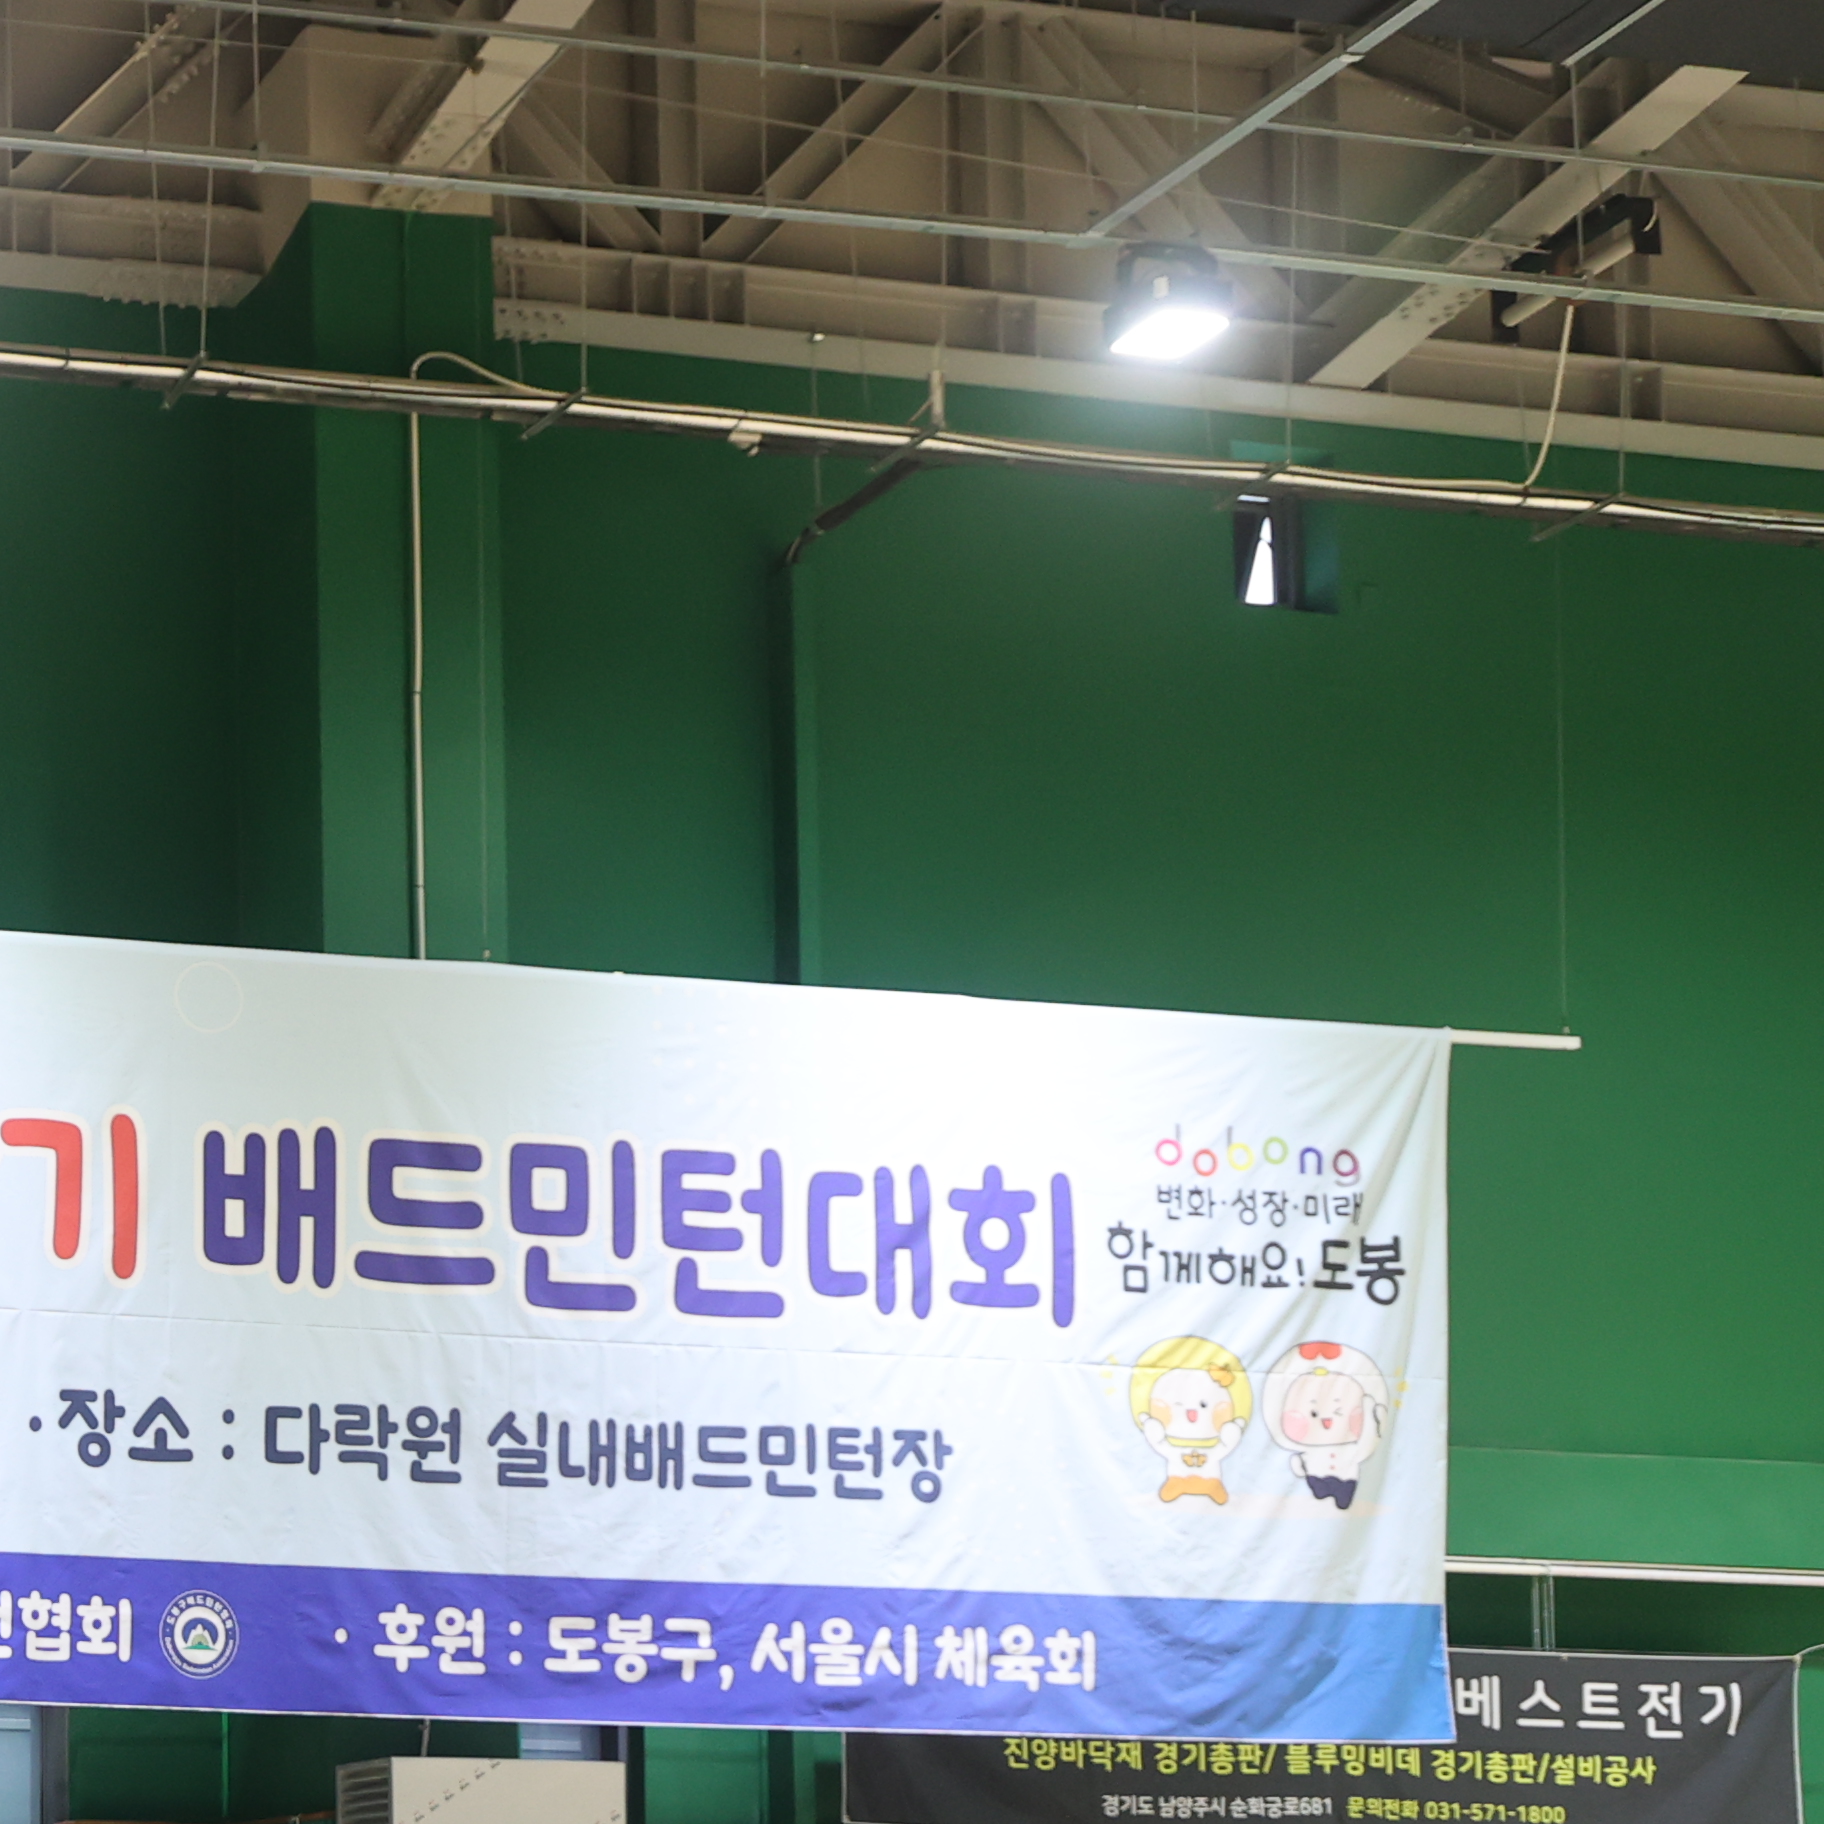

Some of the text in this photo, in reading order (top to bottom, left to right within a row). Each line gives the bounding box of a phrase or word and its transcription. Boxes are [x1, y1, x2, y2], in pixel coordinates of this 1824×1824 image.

[1155, 1124, 1361, 1186] dobong
[203, 1127, 1074, 1328] 배드민턴대회
[1312, 1235, 1405, 1305] 도봉
[264, 1401, 462, 1484] 다락원
[487, 1410, 952, 1502] 실내배드민턴장
[373, 1603, 486, 1676] 후원
[543, 1613, 735, 1693] 도봉구,
[751, 1617, 918, 1689] 서울시
[933, 1623, 1096, 1693] 체육회
[1002, 1736, 1144, 1772] 진양바닥재
[1284, 1743, 1421, 1778] 블루밍비데
[1101, 1794, 1567, 1824] 경기도 남양주시 순화궁로681 문의전화 031-571-1800
